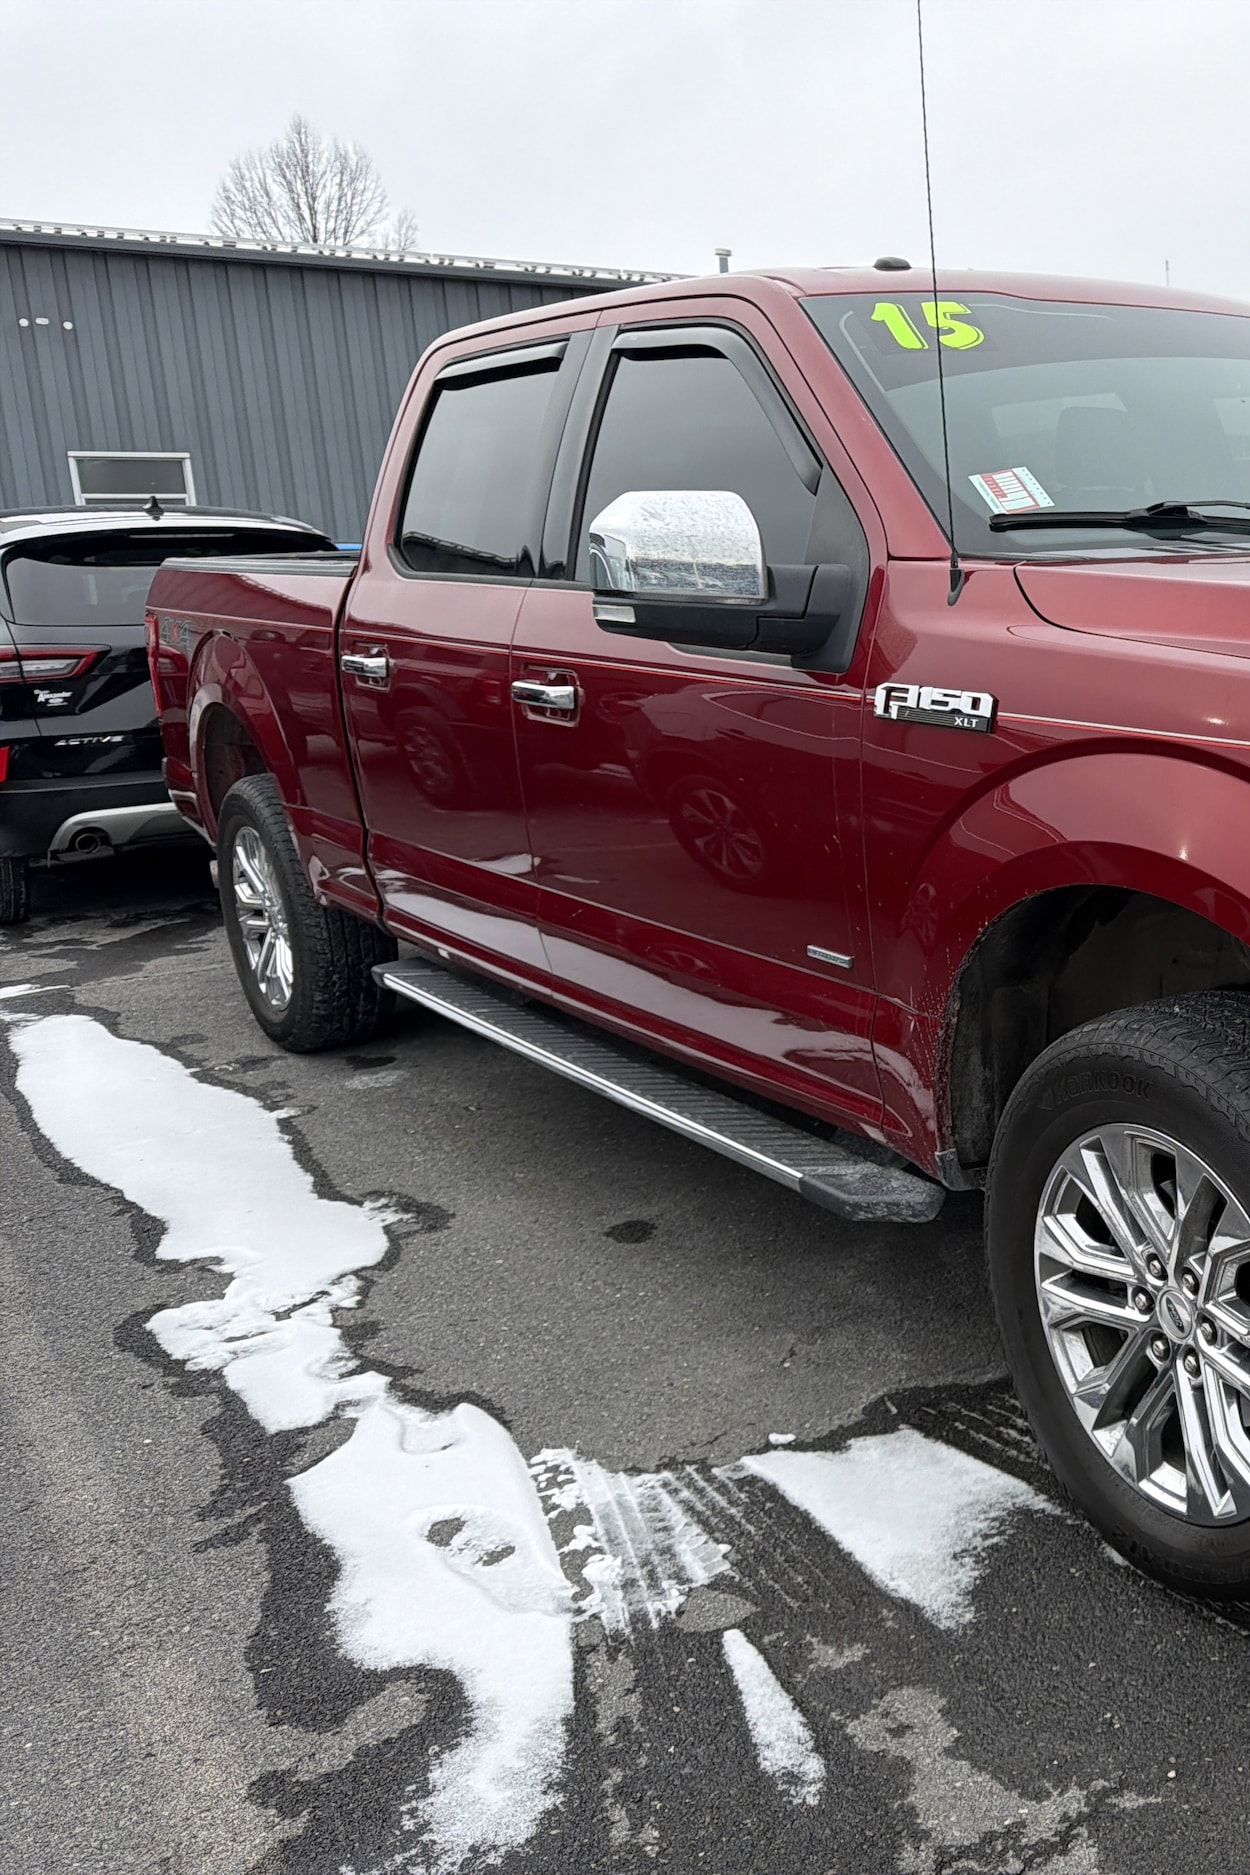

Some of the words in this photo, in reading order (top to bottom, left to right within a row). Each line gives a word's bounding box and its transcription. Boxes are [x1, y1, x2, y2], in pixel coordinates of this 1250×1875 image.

[870, 301, 985, 350] 15
[954, 716, 979, 728] XLT
[54, 735, 124, 746] ACTIVE
